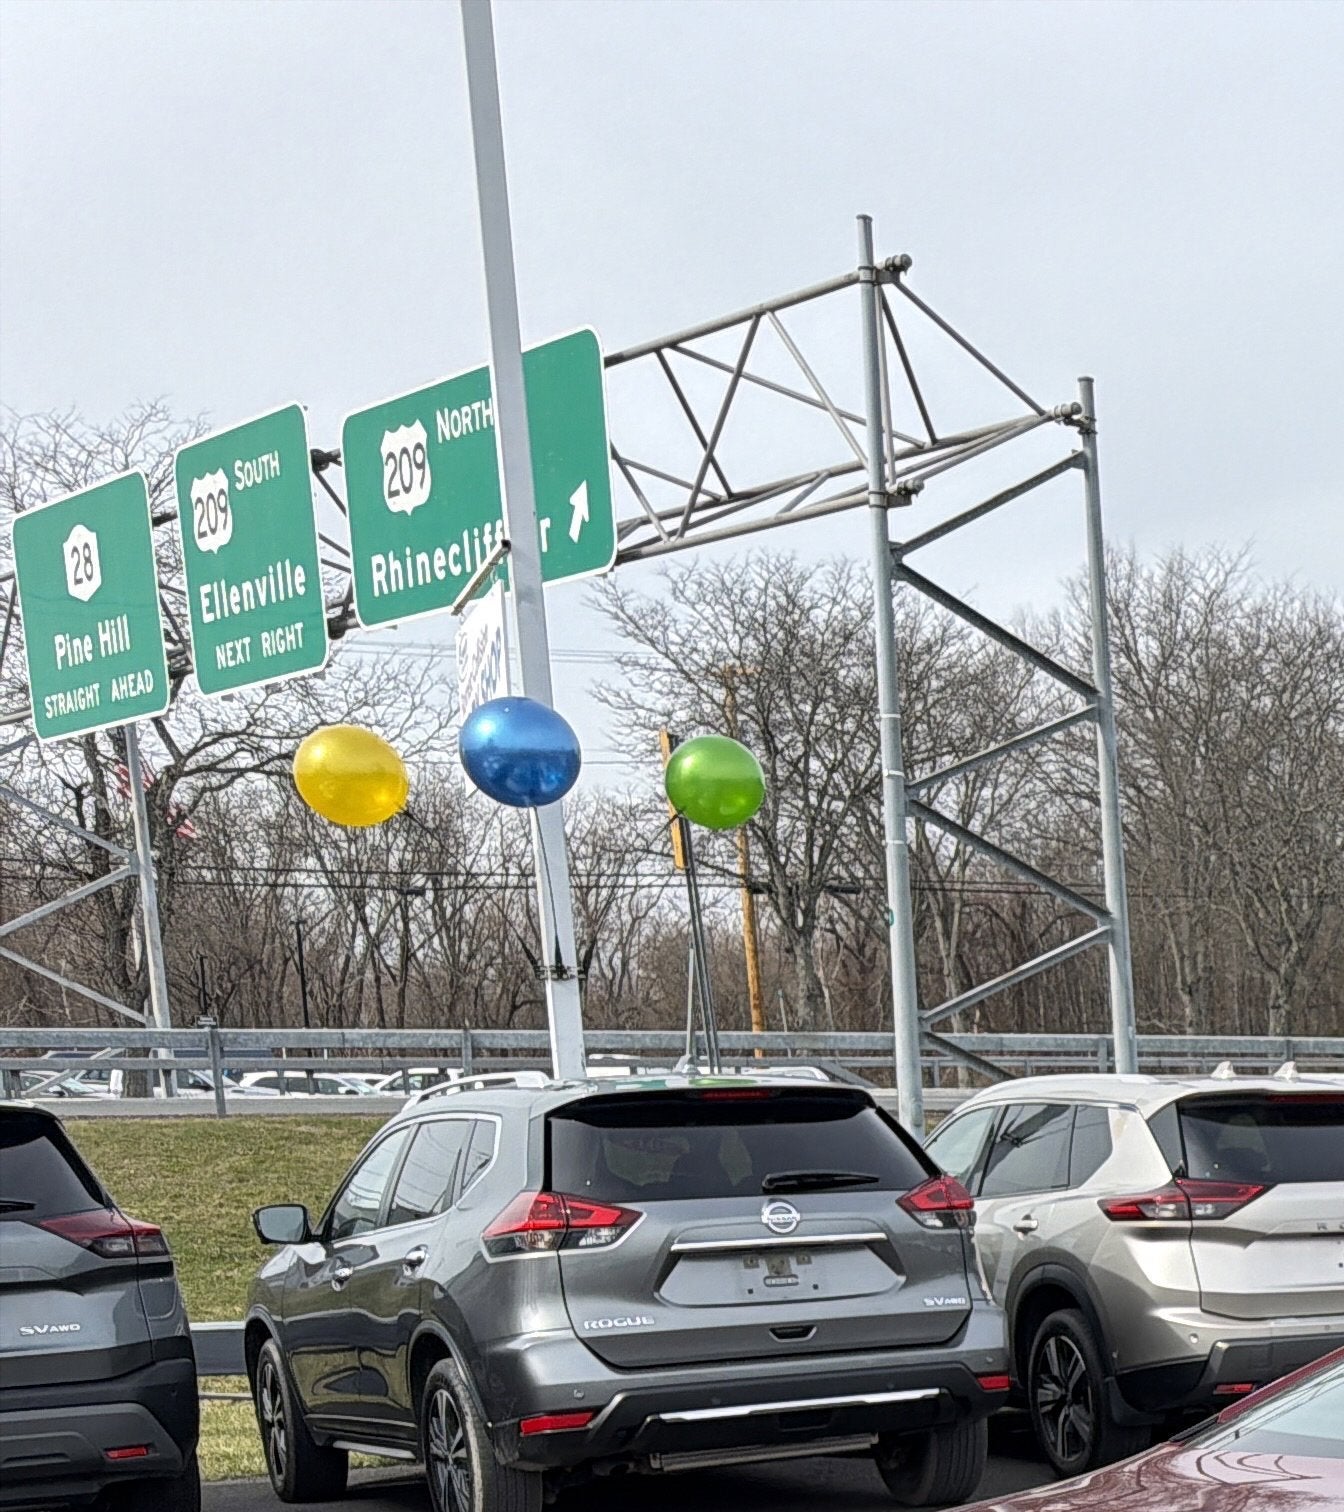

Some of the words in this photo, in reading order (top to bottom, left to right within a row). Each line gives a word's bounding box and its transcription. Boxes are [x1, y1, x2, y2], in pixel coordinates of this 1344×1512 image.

[435, 397, 495, 444] NORTH
[234, 450, 281, 491] SOUTH
[384, 442, 427, 500] 209
[195, 488, 229, 540] 209
[70, 541, 95, 586] 28
[199, 559, 307, 625] Ellenville
[54, 634, 93, 671] Pine
[97, 614, 132, 658] Hill
[215, 637, 252, 670] NEXT
[261, 622, 305, 658] RIGHT
[44, 682, 101, 719] STRAIGHT
[110, 669, 154, 702] AHEAD
[19, 1324, 49, 1336] SV
[583, 1315, 655, 1330] ROGUE
